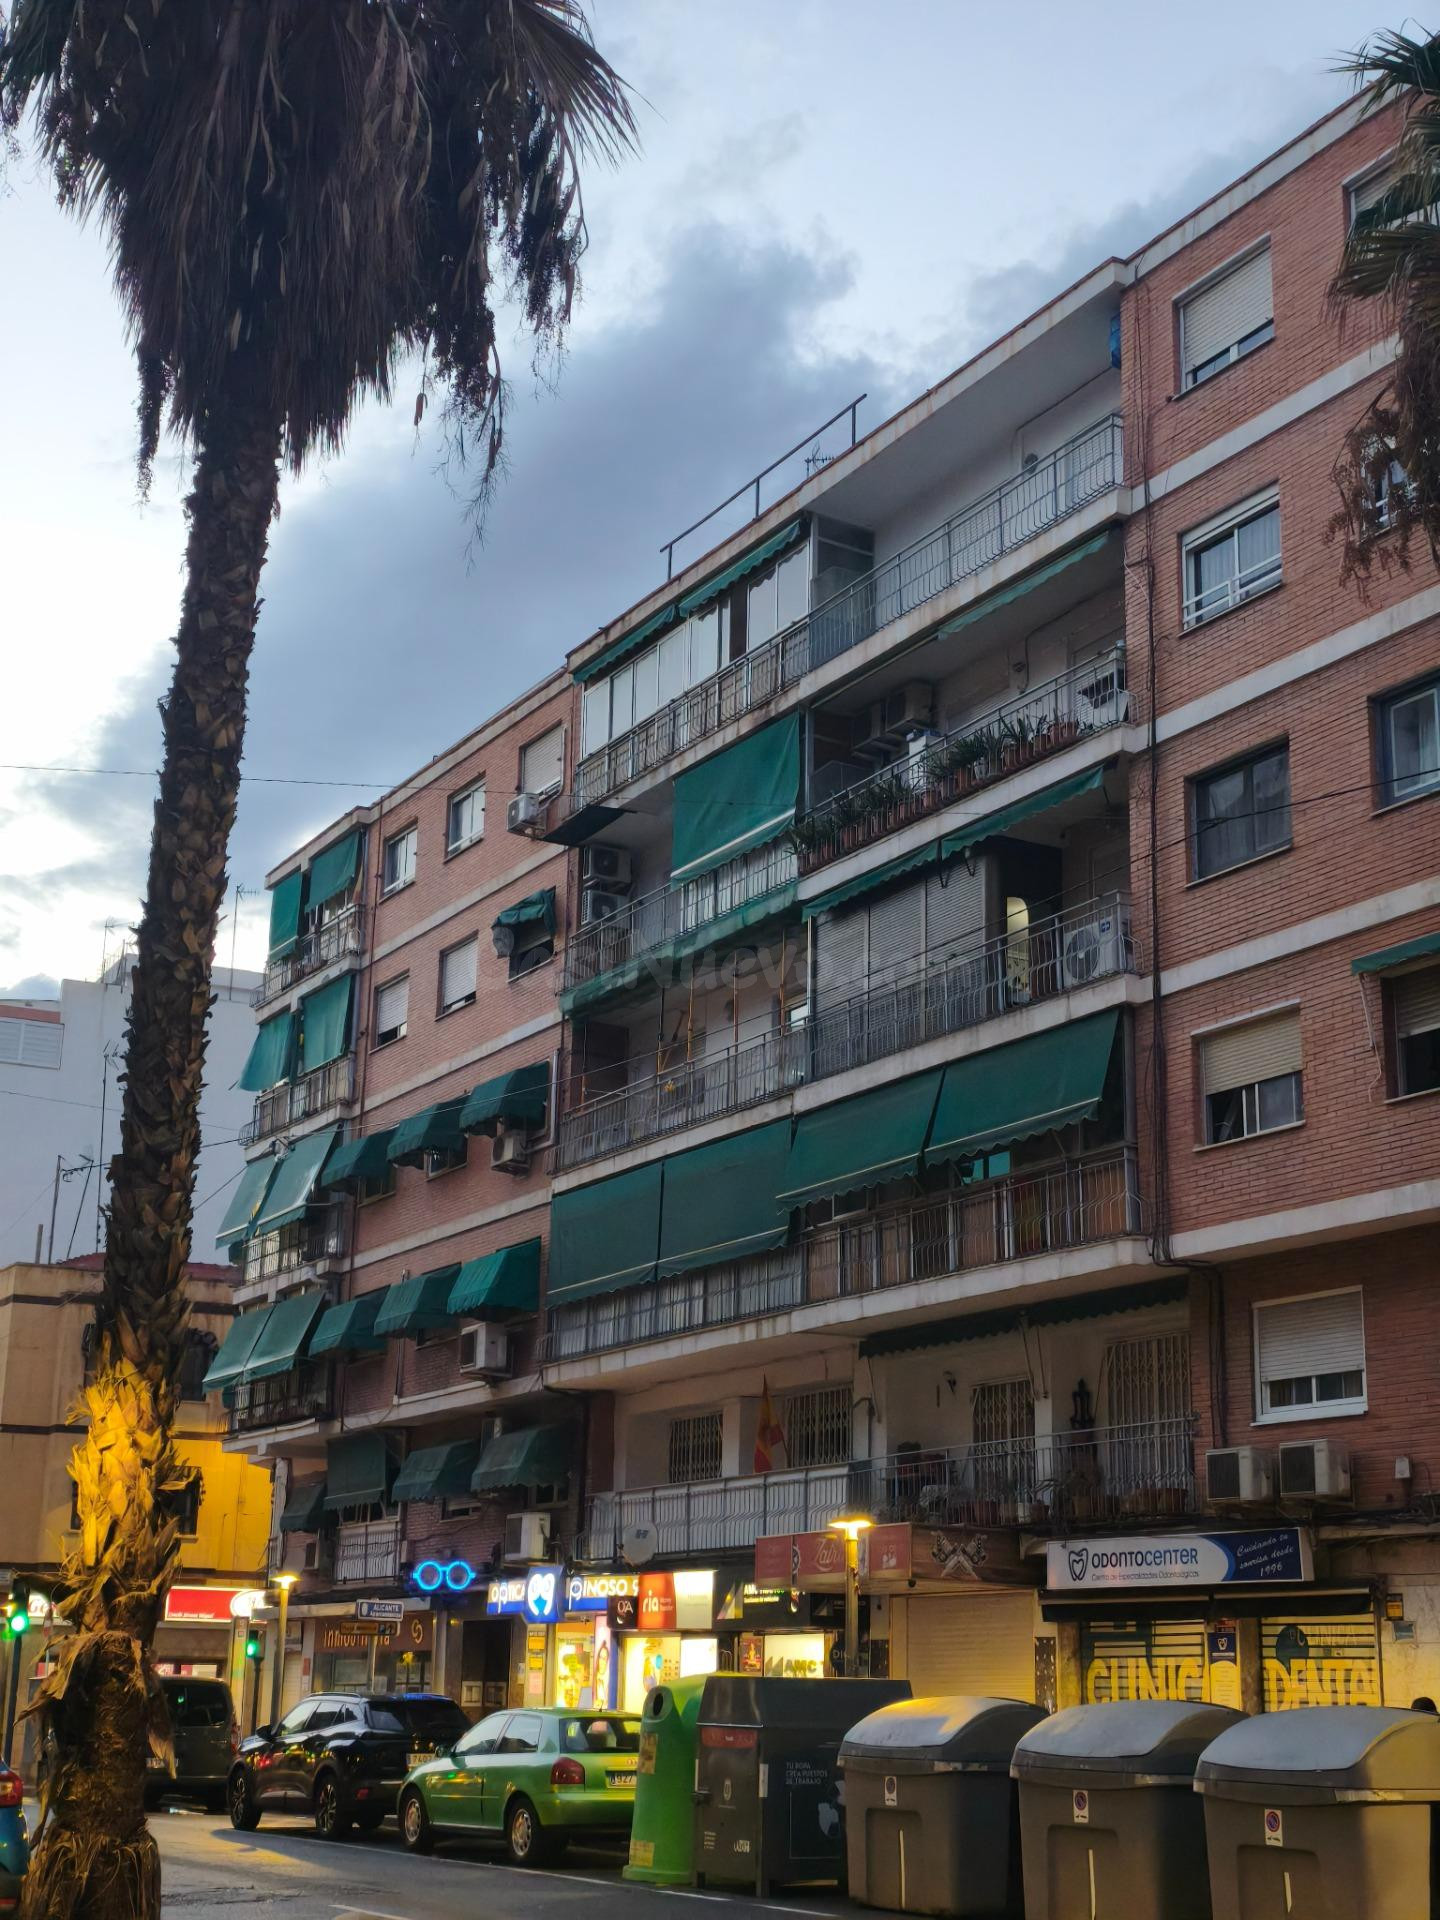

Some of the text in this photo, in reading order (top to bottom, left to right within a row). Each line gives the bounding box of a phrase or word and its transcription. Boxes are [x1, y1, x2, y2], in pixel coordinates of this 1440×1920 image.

[1237, 1537, 1277, 1557] Cuidando
[1239, 1545, 1294, 1569] sonrisa desde
[1260, 1562, 1283, 1577] 1996
[643, 1590, 659, 1613] ria
